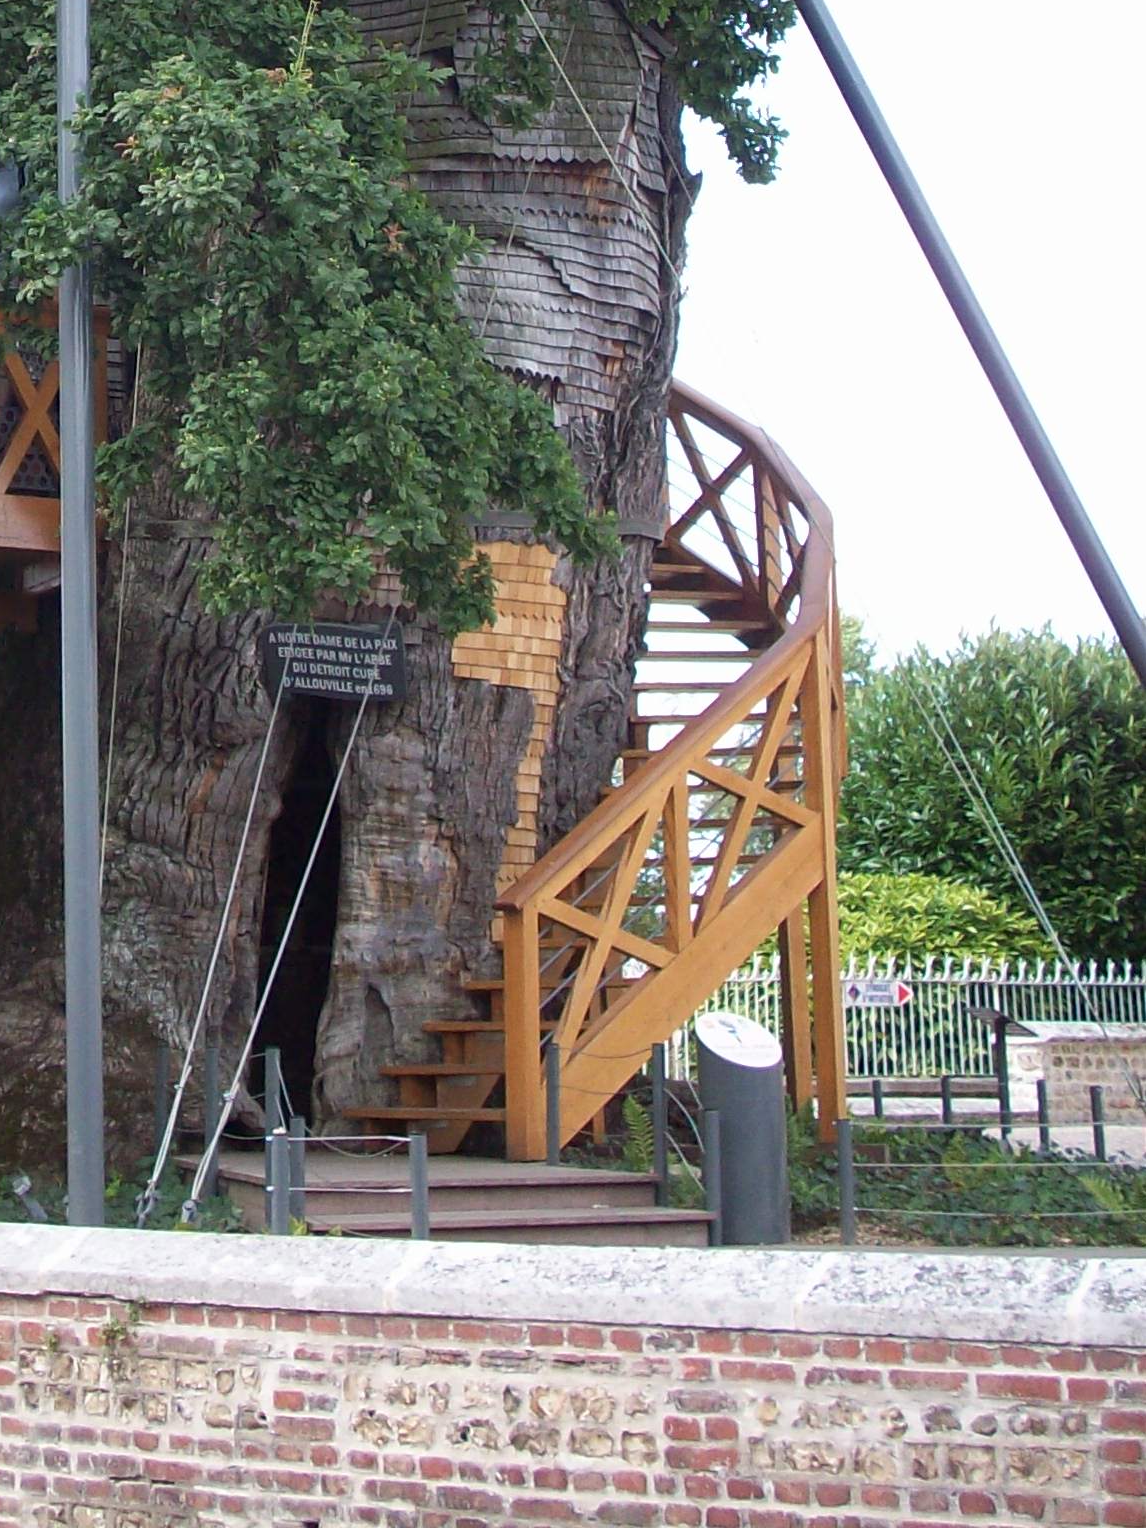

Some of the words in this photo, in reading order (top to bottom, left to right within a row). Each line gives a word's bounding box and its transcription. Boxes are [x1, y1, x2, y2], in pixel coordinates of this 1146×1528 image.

[269, 632, 276, 643] A
[278, 632, 311, 645] NOTRE
[313, 634, 343, 647] DAME
[344, 637, 358, 649] DE
[360, 638, 373, 650] LA
[374, 639, 398, 650] PAIX
[316, 649, 336, 661] PAR
[338, 651, 352, 663] Mr
[354, 653, 392, 666] L'ABBE
[293, 662, 308, 673] DU
[310, 663, 350, 678] DETROIT
[284, 676, 353, 693] D'ALLOUVILLE
[355, 685, 367, 694] en
